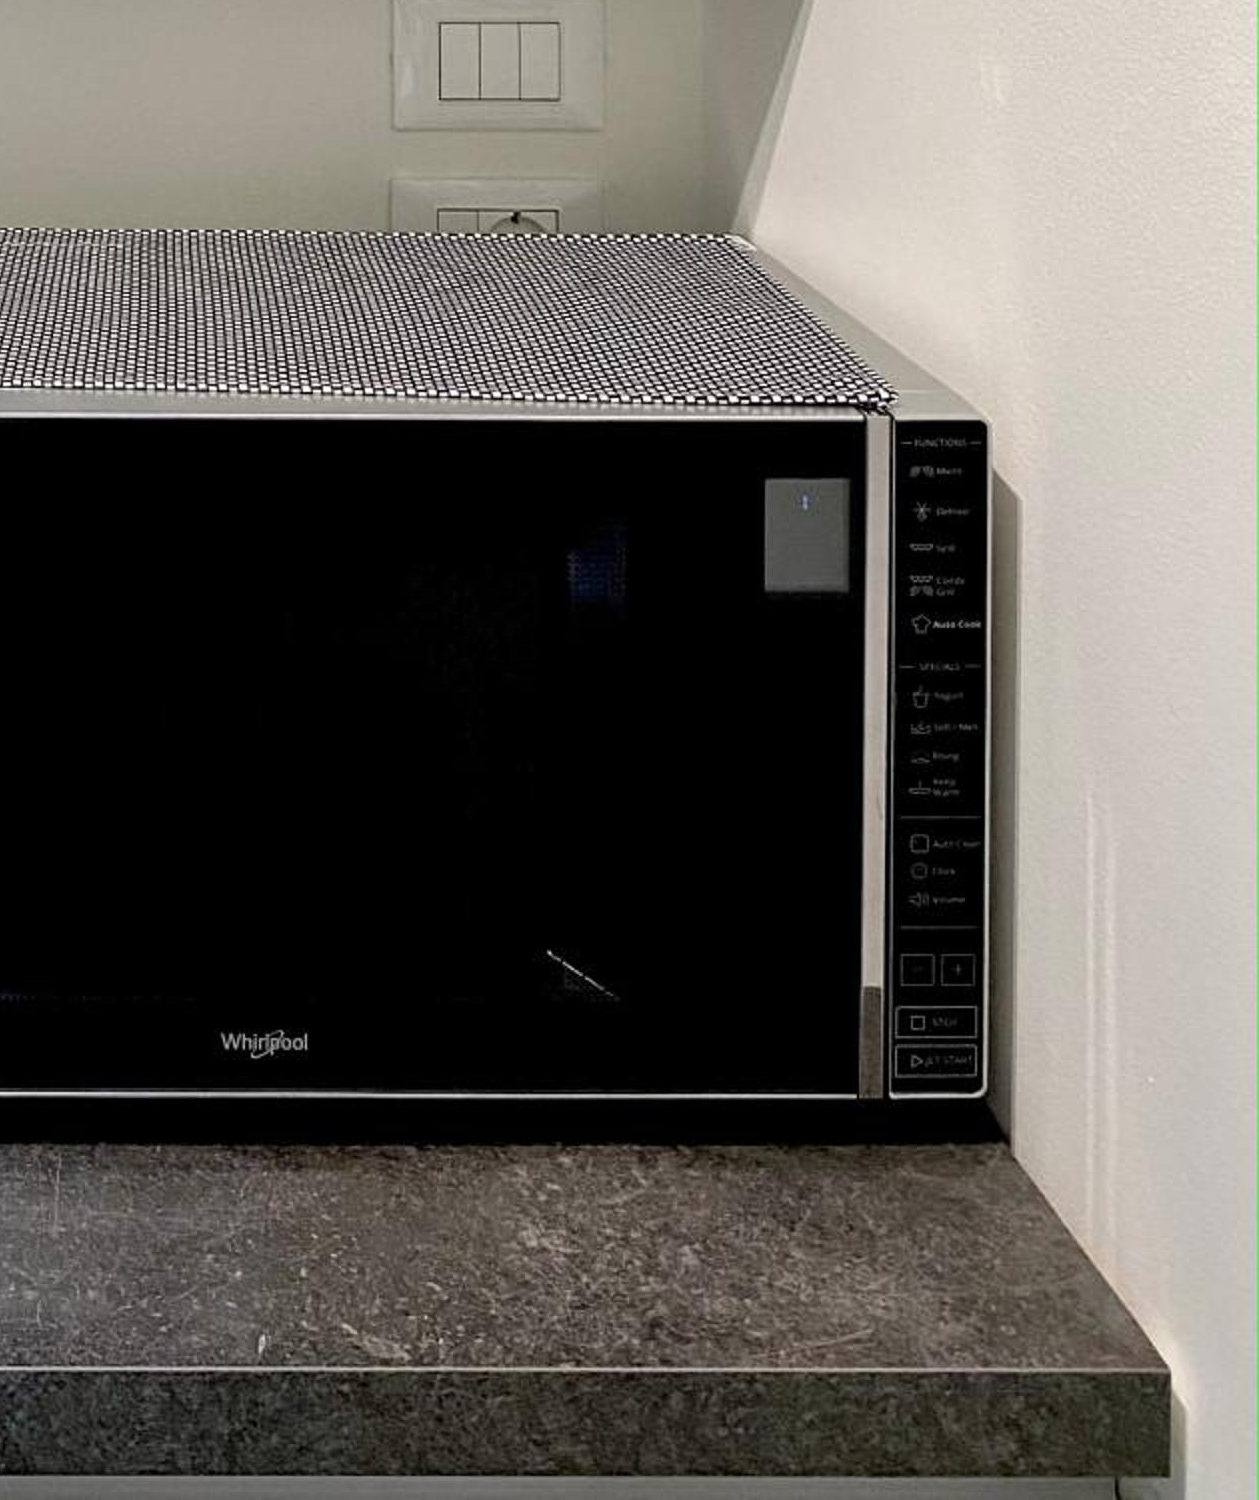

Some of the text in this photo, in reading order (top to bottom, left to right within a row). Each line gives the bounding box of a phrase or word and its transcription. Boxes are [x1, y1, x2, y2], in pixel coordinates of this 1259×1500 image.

[932, 620, 981, 629] Auto Cook
[220, 1030, 308, 1058] Whirlpool
